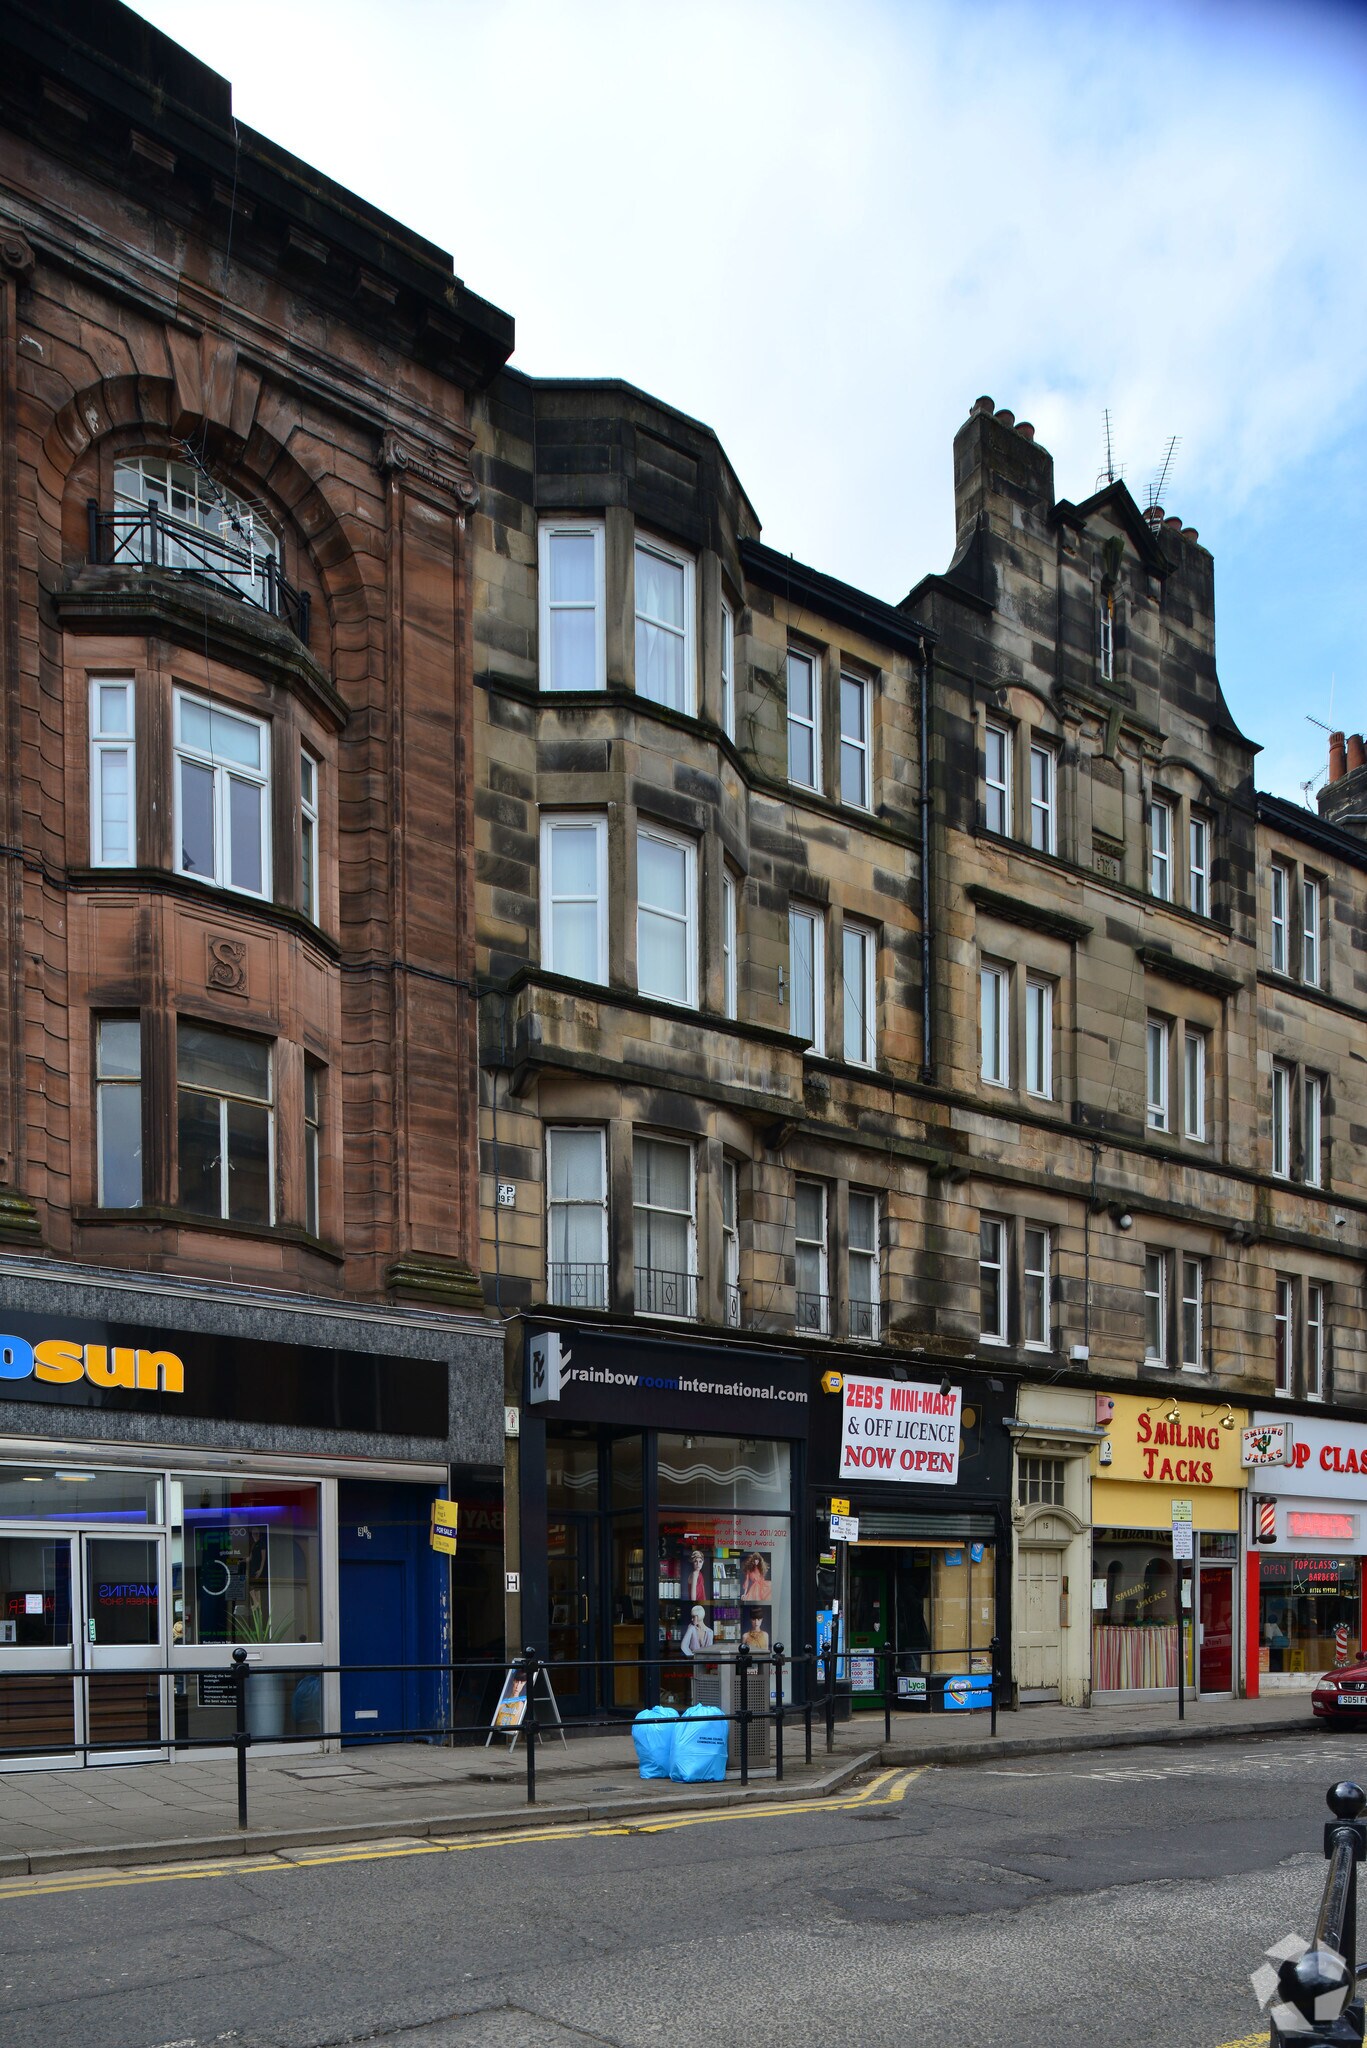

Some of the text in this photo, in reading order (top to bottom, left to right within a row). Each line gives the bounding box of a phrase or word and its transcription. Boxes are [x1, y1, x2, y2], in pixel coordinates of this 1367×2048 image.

[571, 1366, 808, 1403] rainbowroominternational.com
[846, 1384, 957, 1416] ZEB'S MINI-MART
[848, 1416, 956, 1443] & OFF LICENCE
[1244, 1427, 1284, 1440] SMILING
[844, 1445, 954, 1473] NOW OPEN
[1244, 1448, 1283, 1464] JACKS
[1264, 1564, 1286, 1575] OPEN
[1308, 1572, 1338, 1582] BARBERS
[506, 1574, 518, 1590] H
[908, 1680, 925, 1689] Lyca
